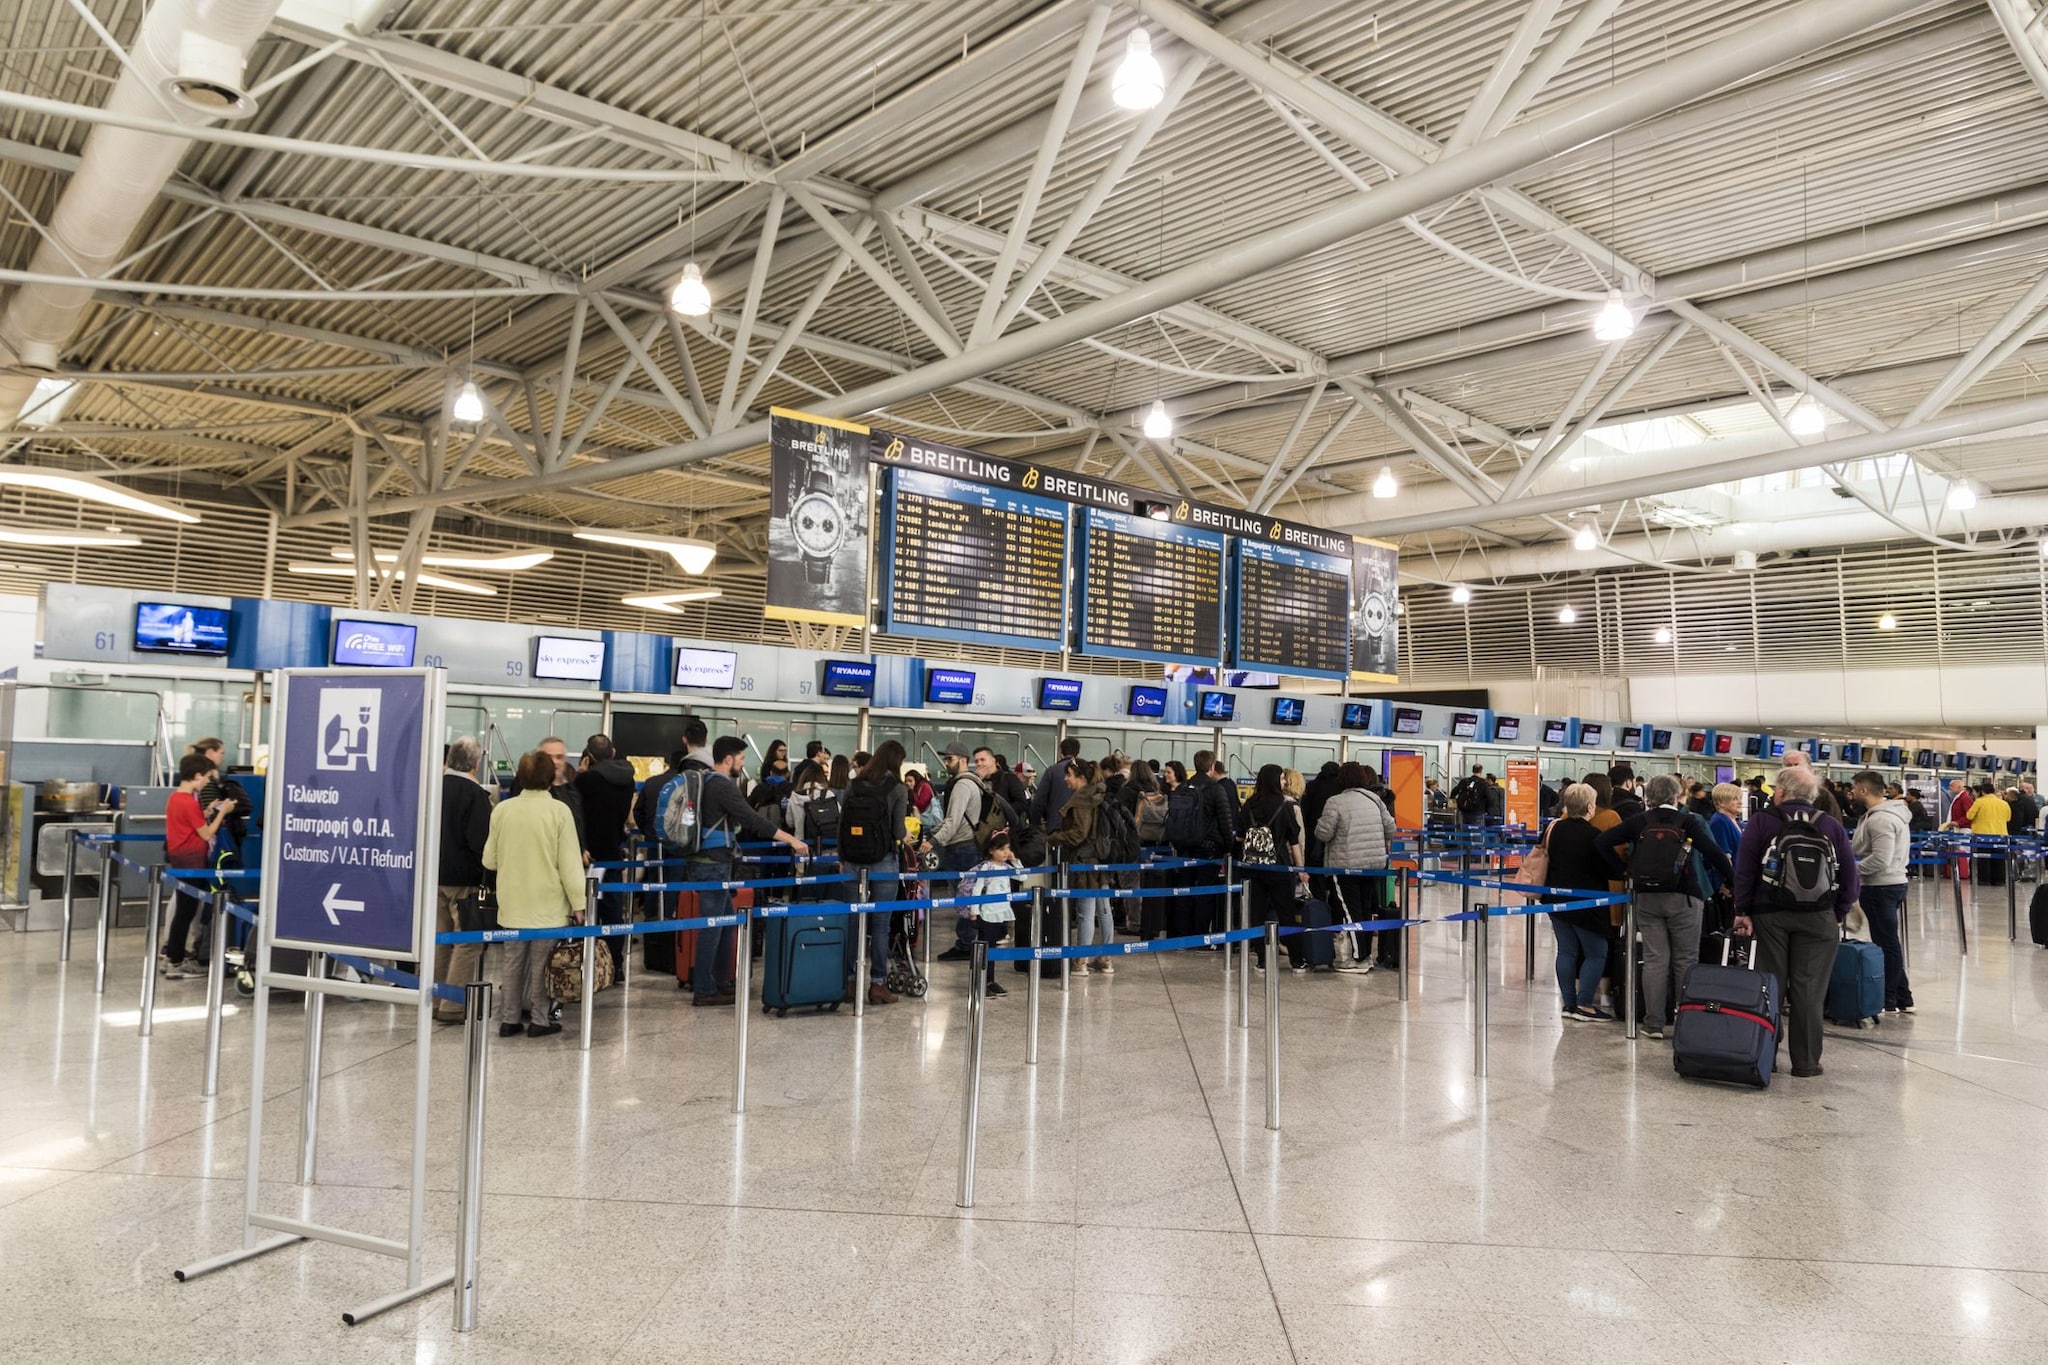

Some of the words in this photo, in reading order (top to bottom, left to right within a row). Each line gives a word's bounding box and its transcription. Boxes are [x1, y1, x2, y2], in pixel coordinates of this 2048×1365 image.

[791, 439, 849, 459] BREITLING
[910, 447, 1010, 482] BREITLING
[952, 479, 990, 496] Departures
[1044, 476, 1129, 507] BREITLING
[928, 498, 963, 511] Copenhagen
[1192, 508, 1262, 535] BREITLING
[1284, 528, 1345, 553] BREITLING
[95, 632, 115, 650] 61
[362, 641, 384, 651] FREE
[556, 657, 590, 665] express
[506, 661, 523, 677] 59
[694, 665, 723, 674] express
[836, 666, 872, 676] RYANAIR
[740, 677, 754, 691] 58
[939, 675, 971, 684] RYANAIR
[800, 680, 812, 694] 57
[1050, 684, 1079, 692] RYANAIR
[975, 693, 986, 706] 56
[1020, 696, 1031, 709] 55
[1114, 703, 1123, 714] 54
[287, 784, 340, 805] Τελωνείο
[285, 813, 348, 839] Επιστροφή
[352, 817, 394, 838] Φ.Π.Α.
[284, 842, 329, 864] Customs
[339, 846, 369, 866] V.A.T
[371, 848, 413, 869] Refund
[1130, 941, 1149, 949] ATHENS
